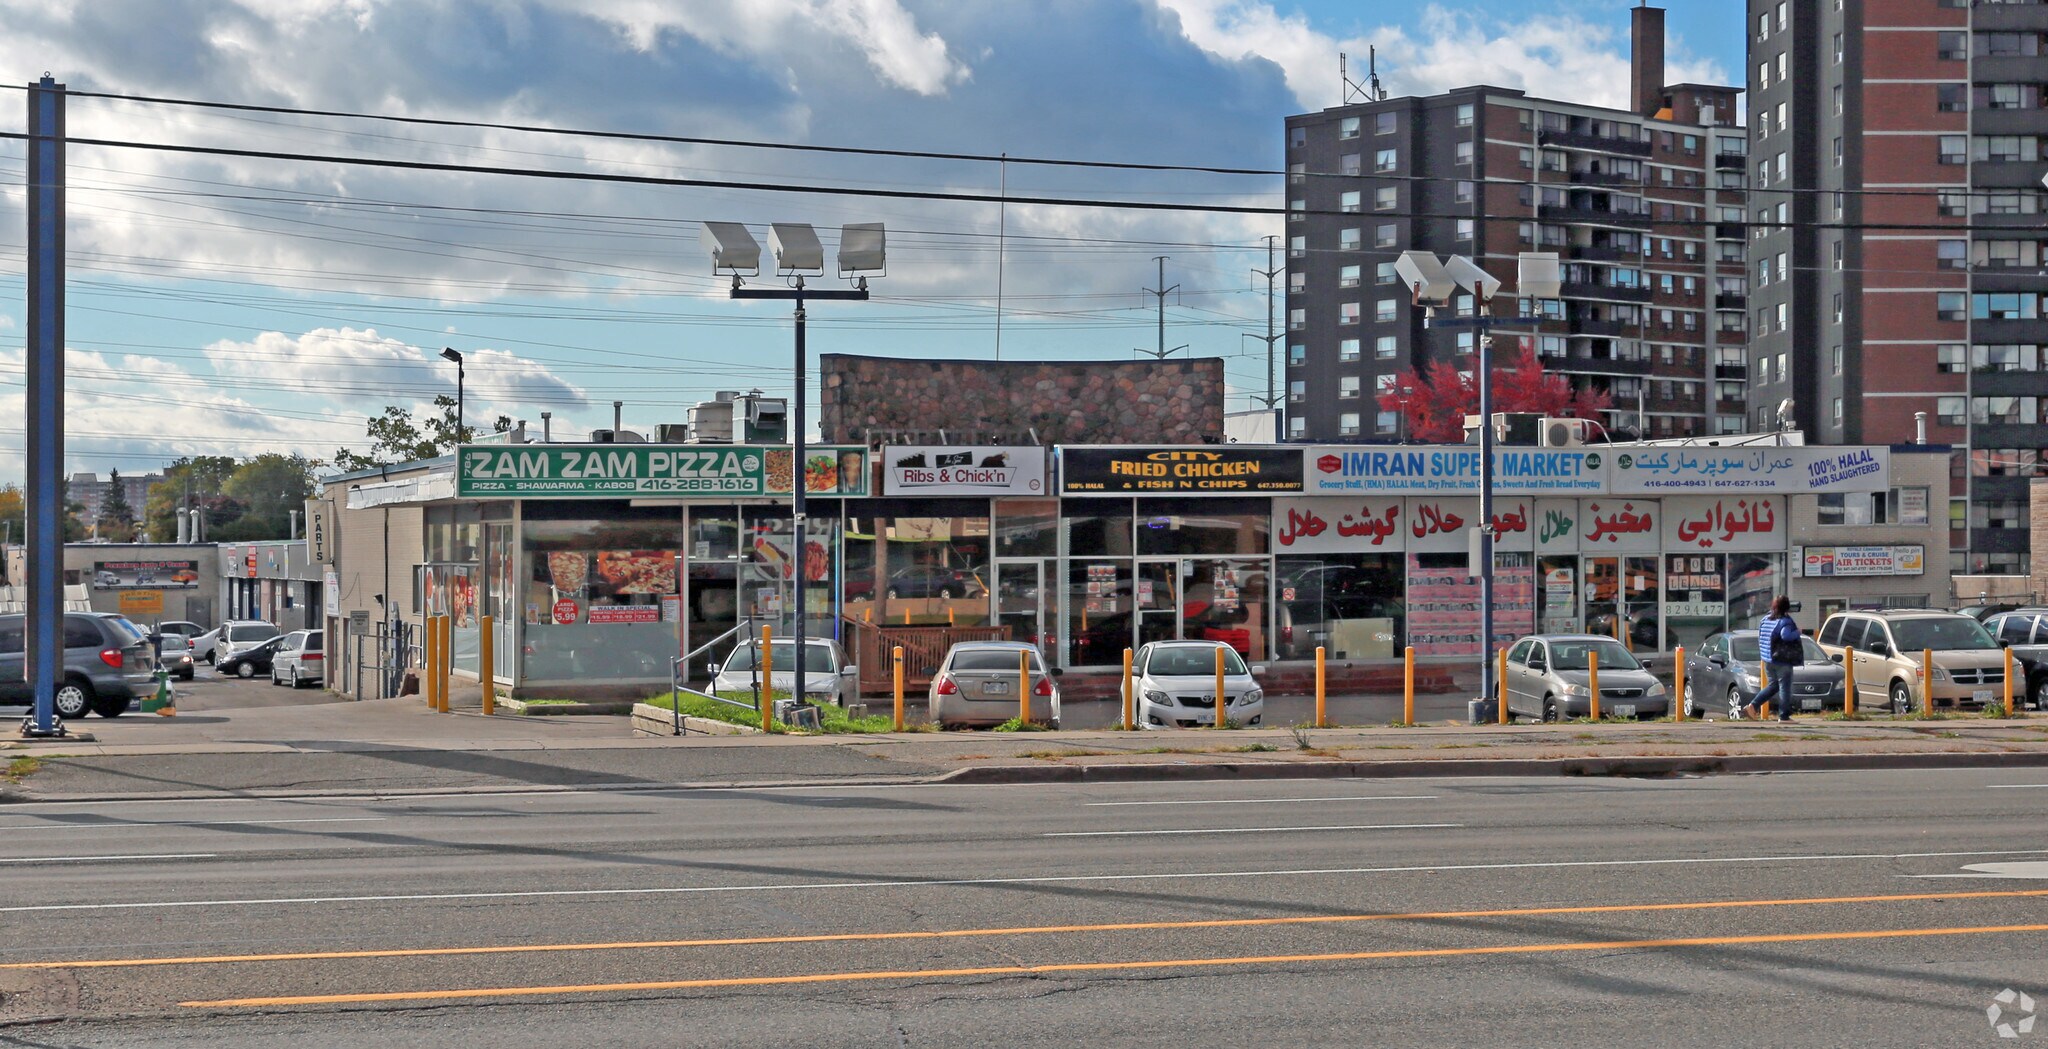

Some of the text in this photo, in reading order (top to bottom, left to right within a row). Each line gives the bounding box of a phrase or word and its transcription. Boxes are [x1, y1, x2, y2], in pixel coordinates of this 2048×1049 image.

[464, 452, 472, 477] 786
[471, 451, 744, 478] ZAM ZAM PIZZA
[1147, 451, 1223, 461] CITY
[1342, 452, 1425, 477] IMRAN
[1502, 452, 1584, 477] MARKET
[1748, 451, 1794, 473] عمران
[1808, 449, 1874, 477] 100% HALAL
[904, 468, 1006, 483] Ribs & Chick'n
[1111, 460, 1260, 478] FRIED CHICKEN
[1809, 462, 1880, 489] HAND SLAUGHTERED
[472, 482, 506, 490] PIZZA
[516, 482, 585, 490] SHAWARMA
[641, 479, 754, 490] 416-288-1616
[1138, 481, 1174, 489] FISH
[1180, 481, 1193, 489] N
[1198, 480, 1248, 488] CHIPS
[1319, 480, 1344, 490] Grocery
[1386, 480, 1409, 489] HALAL
[1428, 480, 1439, 490] Dry
[1459, 480, 1475, 488] Fresh
[1503, 480, 1524, 488] Sweets
[1525, 480, 1537, 488] And
[1539, 480, 1554, 488] Fresh
[1556, 480, 1573, 488] Bread
[1574, 480, 1601, 490] Everyday
[1279, 505, 1399, 546] گوشت حلال
[1412, 503, 1464, 538] حلال
[1540, 509, 1573, 544] حلال
[1585, 502, 1652, 542] مخبز
[1678, 500, 1774, 548] نانوایی
[314, 514, 323, 561] PARTS
[1676, 559, 1713, 571] FOR
[1836, 558, 1853, 566] AIR
[1855, 558, 1892, 566] TICKETS
[1671, 577, 1719, 589] LEASE
[1665, 605, 1723, 615] 8294477
